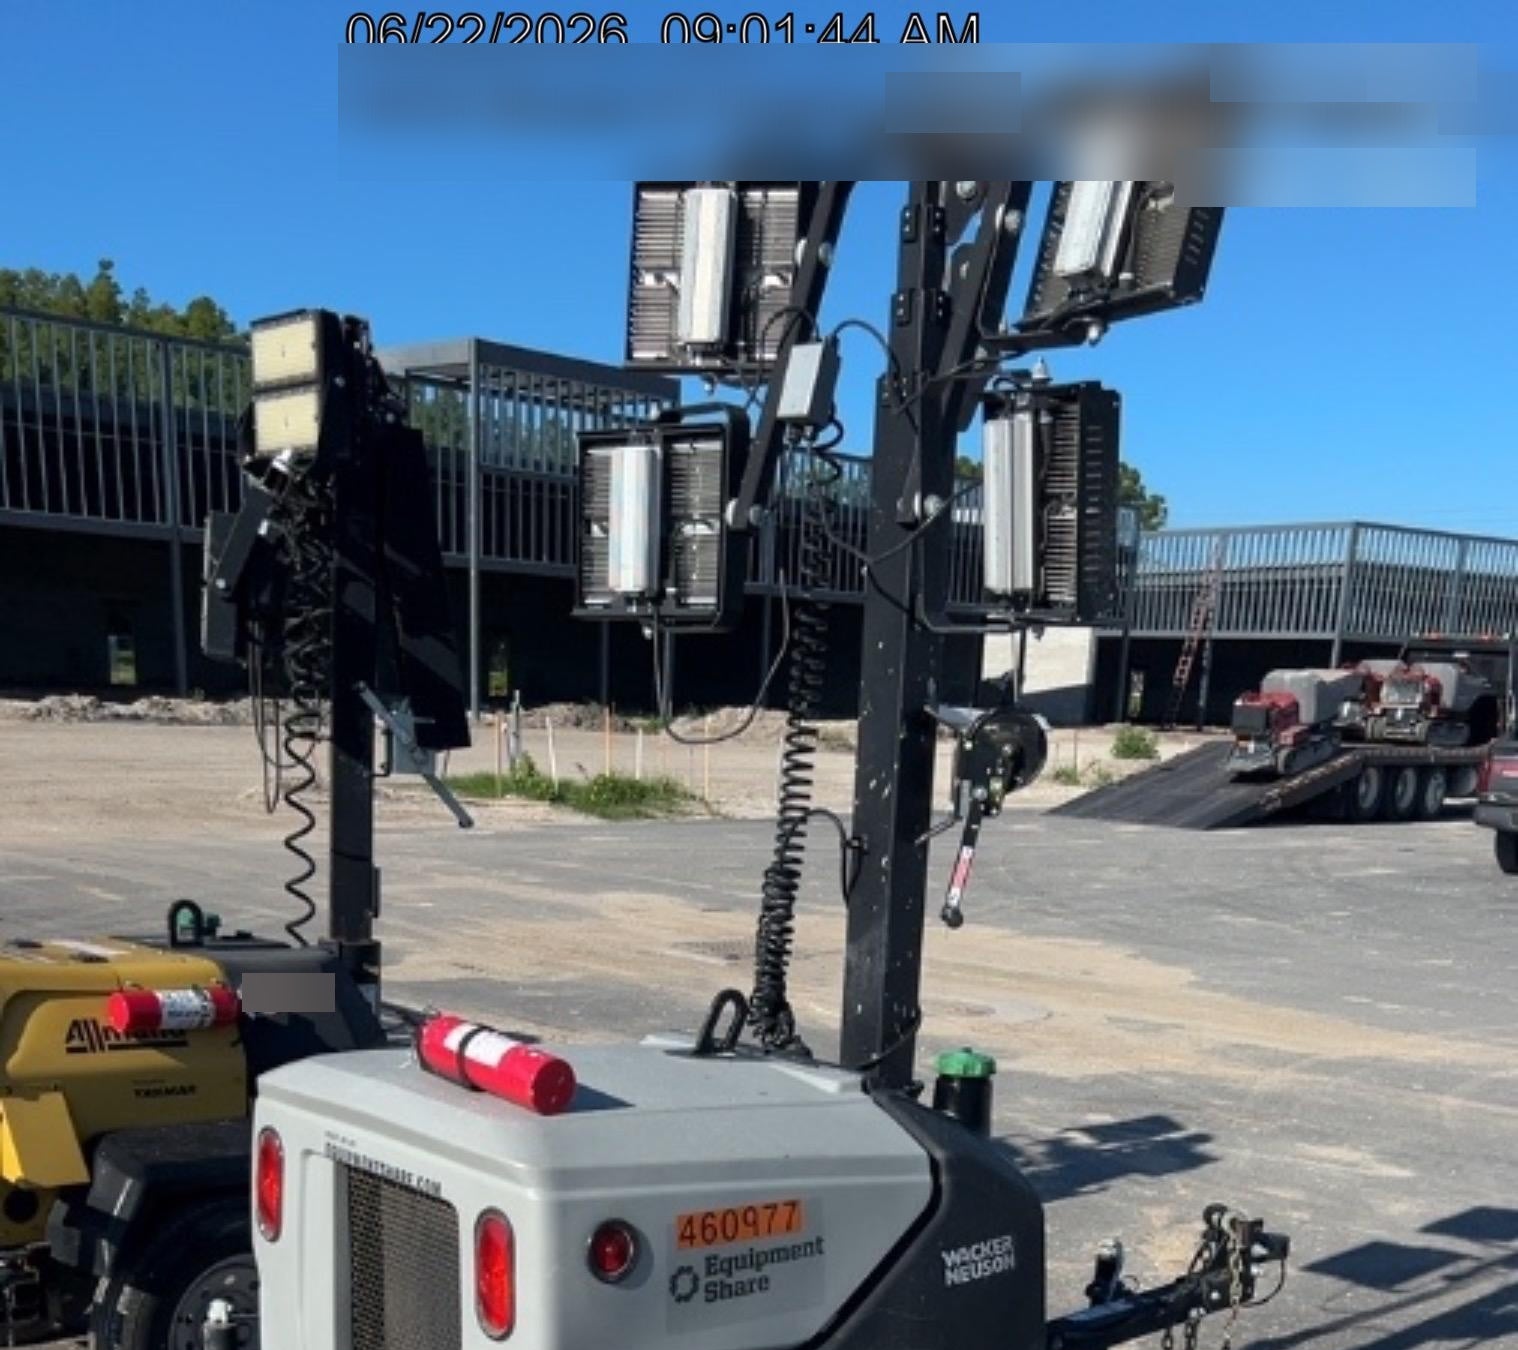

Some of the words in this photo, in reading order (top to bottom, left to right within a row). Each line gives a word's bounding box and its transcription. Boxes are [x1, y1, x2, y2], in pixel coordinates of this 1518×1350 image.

[679, 1201, 798, 1247] 460977
[704, 1235, 824, 1279] Equipment
[941, 1234, 1013, 1268] WACKER
[945, 1252, 1015, 1288] NEUSON
[704, 1274, 770, 1303] Share
